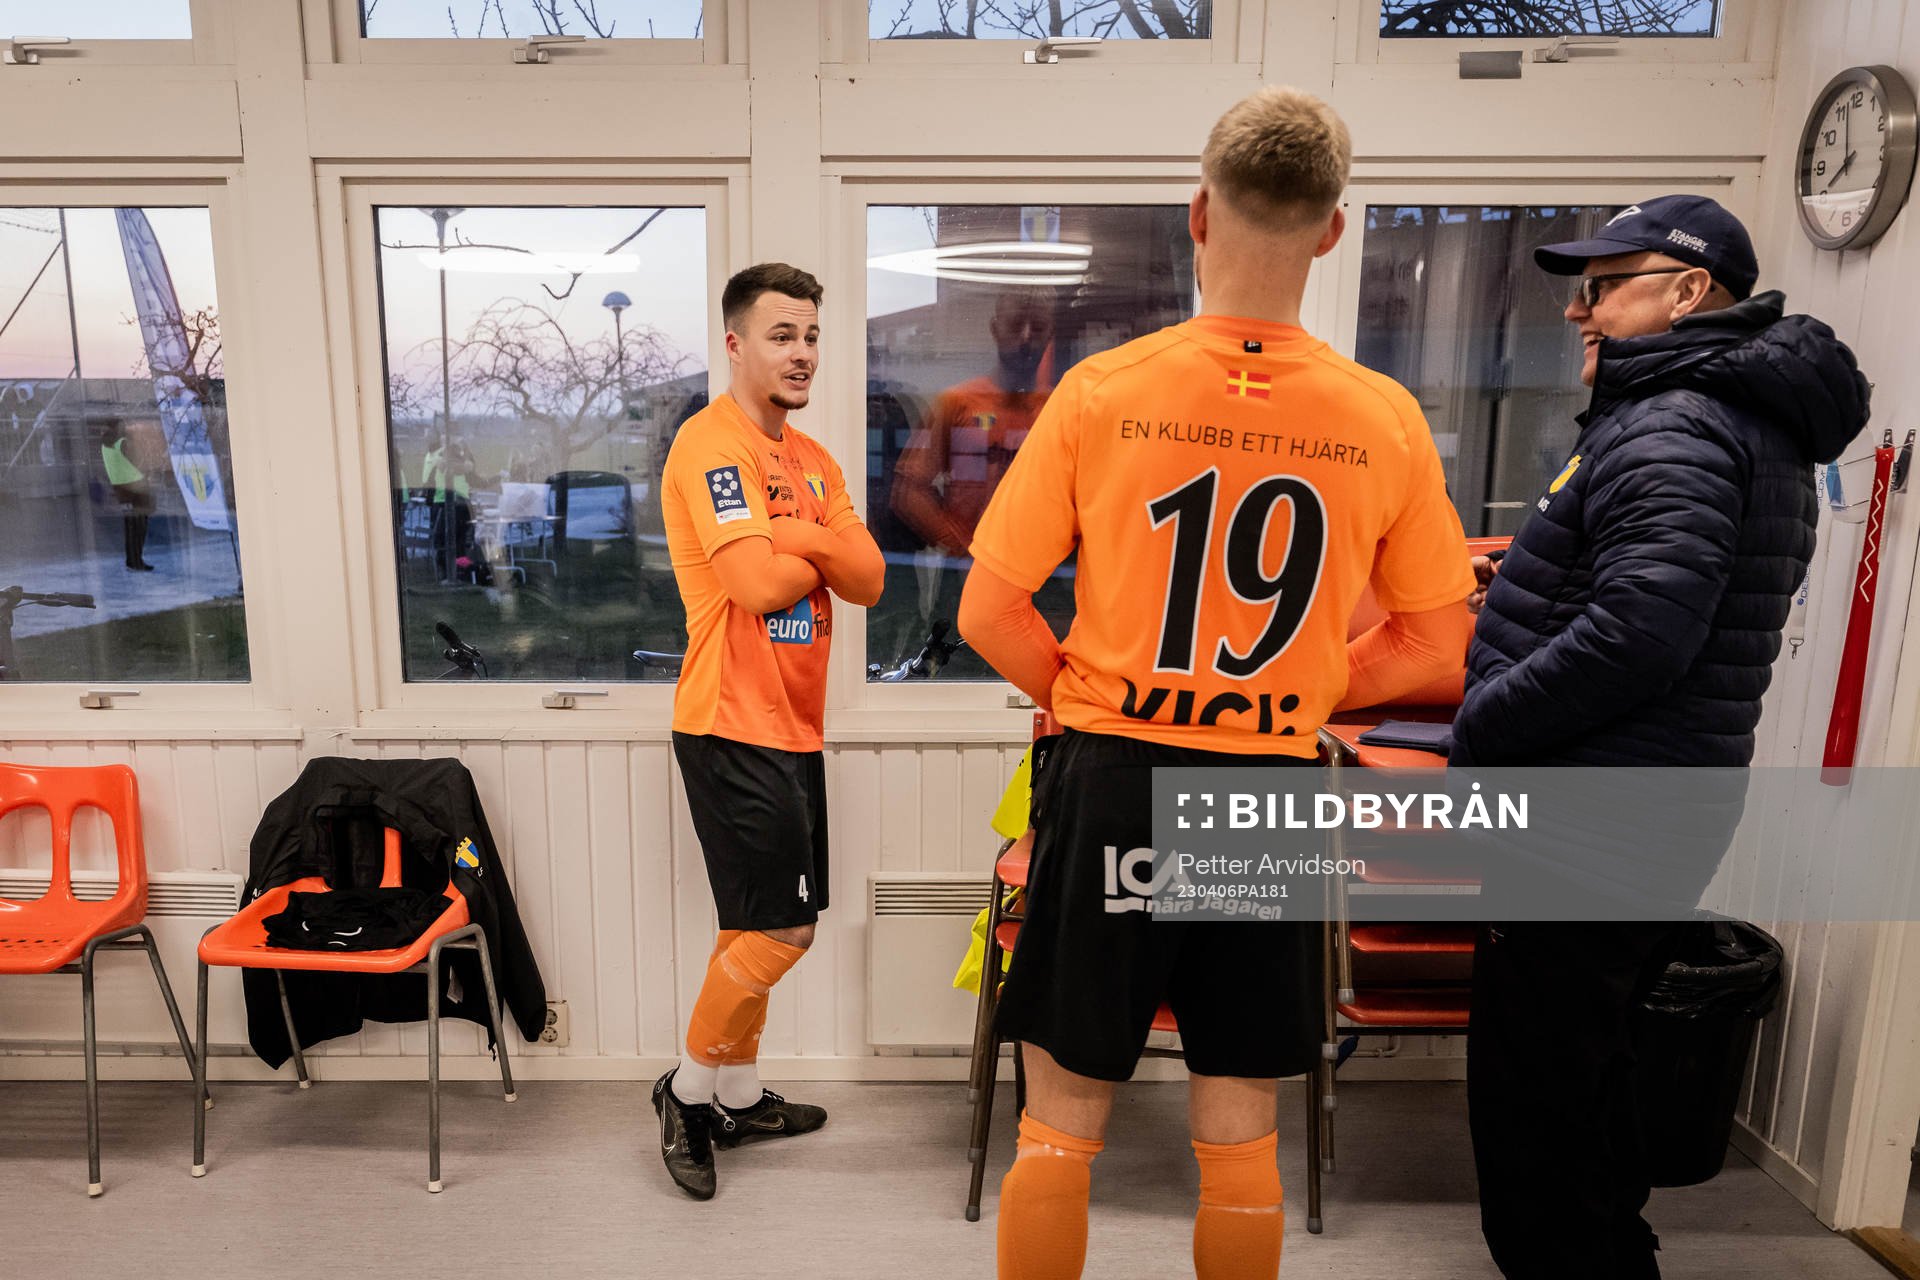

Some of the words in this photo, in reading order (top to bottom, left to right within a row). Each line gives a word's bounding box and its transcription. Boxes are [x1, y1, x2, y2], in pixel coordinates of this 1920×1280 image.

[1850, 91, 1864, 110] 12
[1869, 95, 1876, 112] 1
[1835, 104, 1846, 122] 11
[1877, 115, 1885, 133] 2
[1823, 129, 1837, 148] 10
[1816, 160, 1826, 176] 9
[1841, 211, 1852, 227] 6
[1121, 420, 1150, 439] EN
[1158, 422, 1233, 448] KLUBB
[1242, 432, 1283, 454] ETT
[1290, 437, 1368, 468] HJÄRTA
[717, 498, 742, 508] Ettan
[1145, 465, 1328, 680] 19
[767, 618, 809, 639] euro
[1104, 846, 1192, 896] ICA
[798, 874, 809, 902] 4
[1146, 896, 1194, 914] nära
